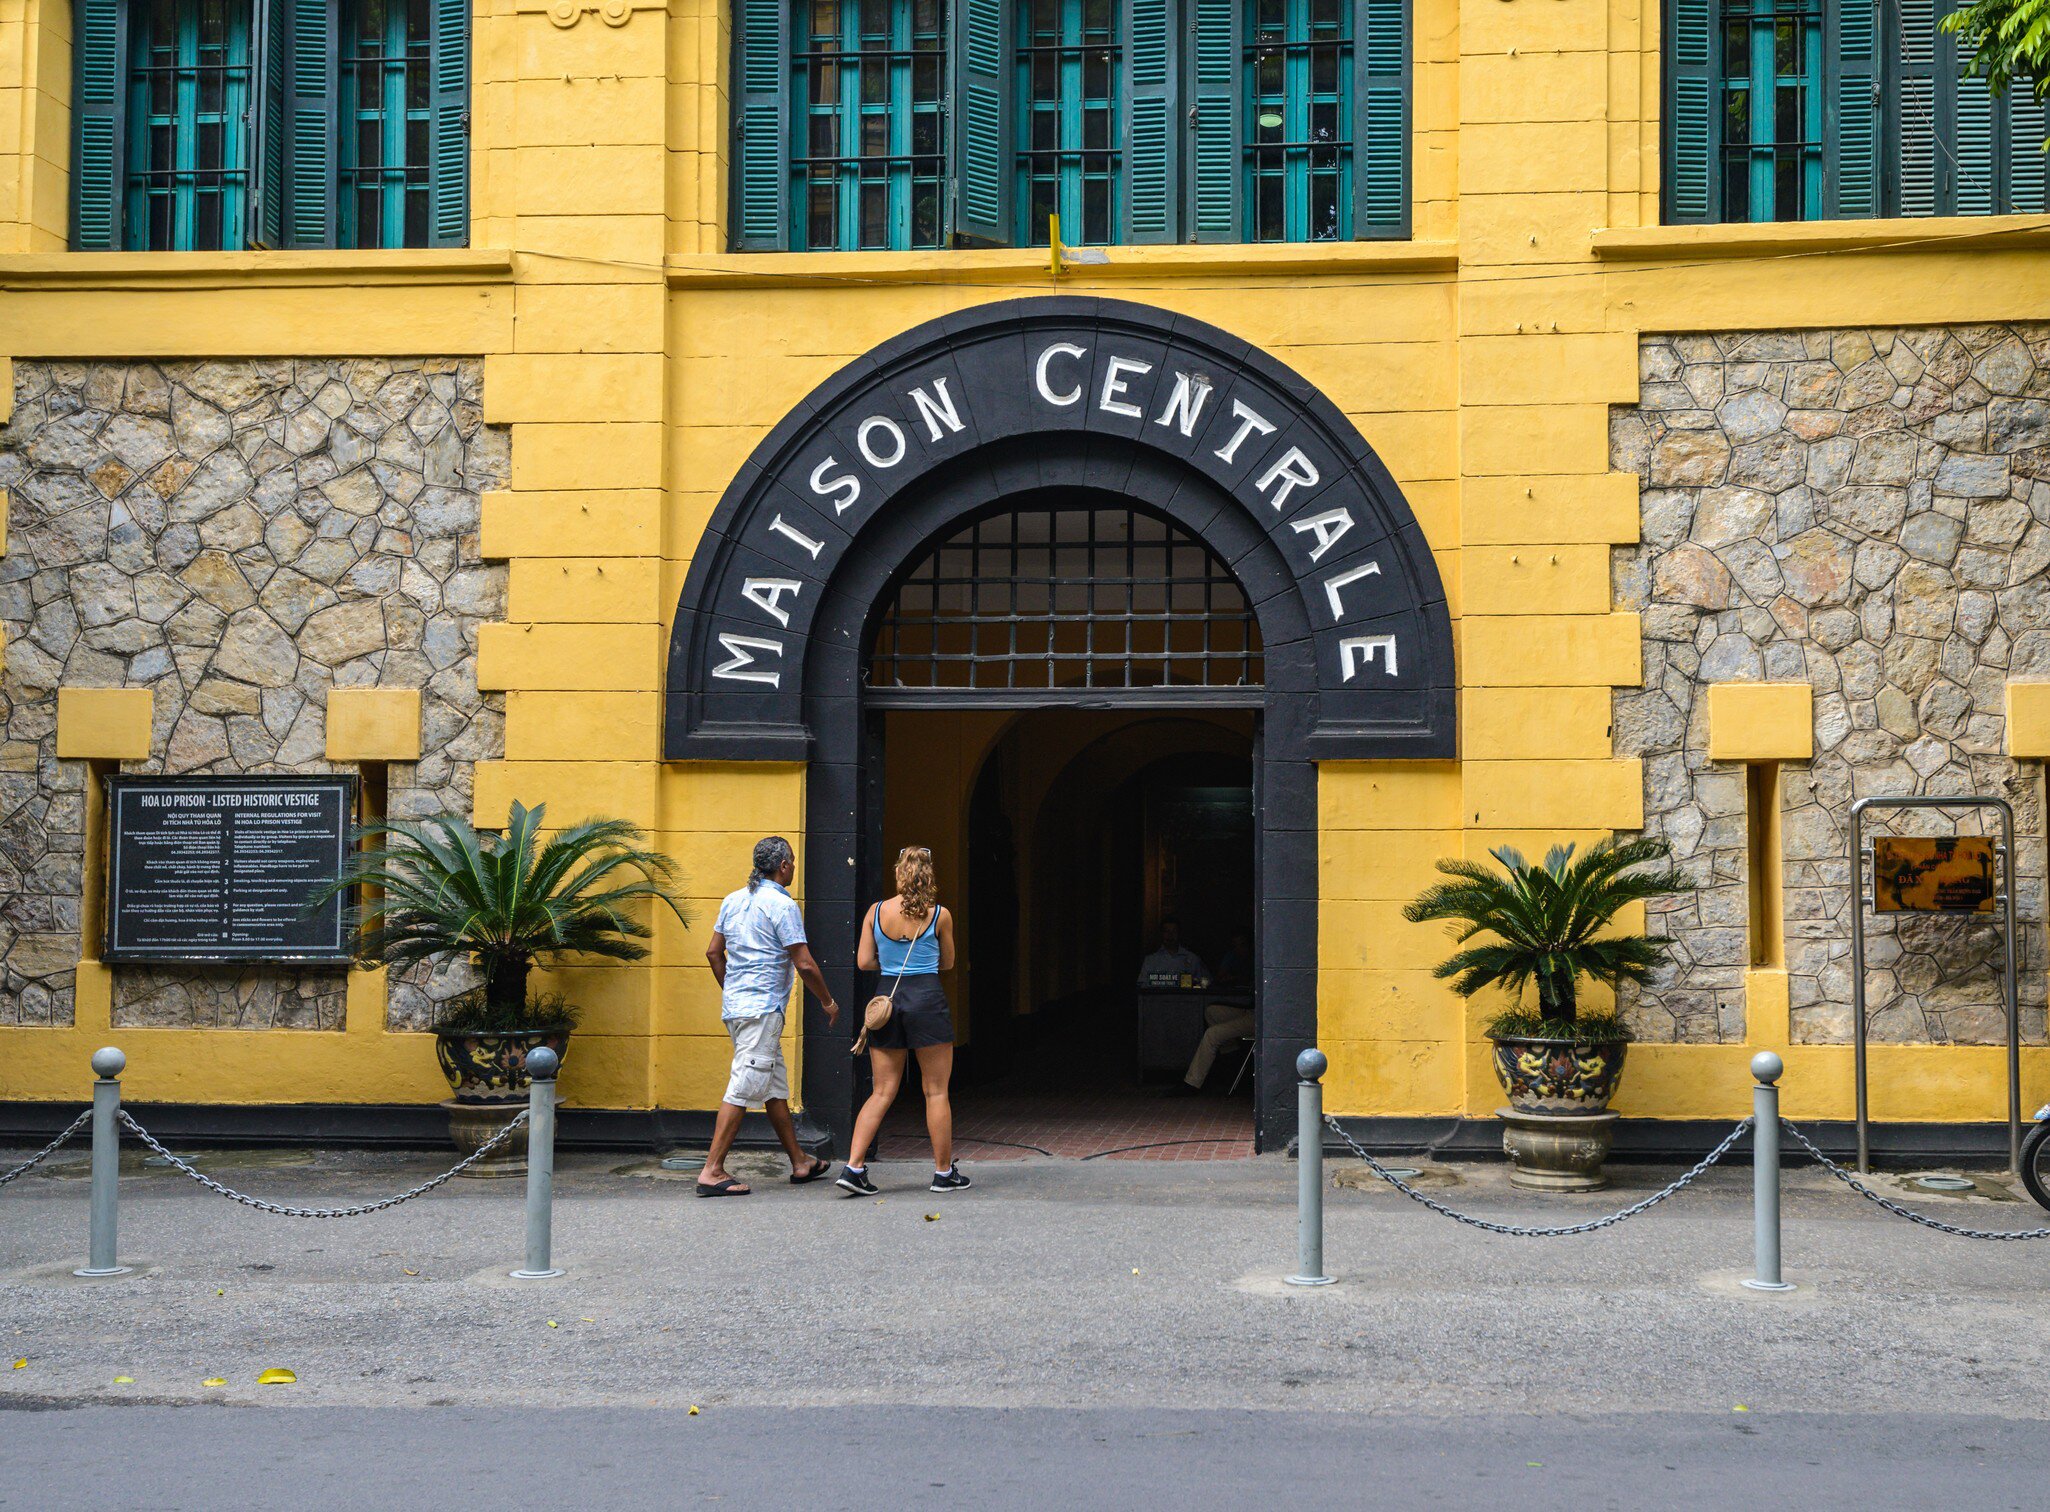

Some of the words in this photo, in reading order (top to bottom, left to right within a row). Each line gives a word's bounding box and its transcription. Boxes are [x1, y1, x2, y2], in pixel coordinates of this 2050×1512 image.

[712, 376, 966, 688] MAISON
[1036, 342, 1398, 682] CENTRALE
[141, 795, 159, 807] HOA
[162, 795, 172, 807] LO
[174, 795, 205, 806] PRISON
[213, 794, 241, 806] LISTED
[244, 794, 283, 806] HISTORIC
[284, 794, 319, 806] VESTIGE
